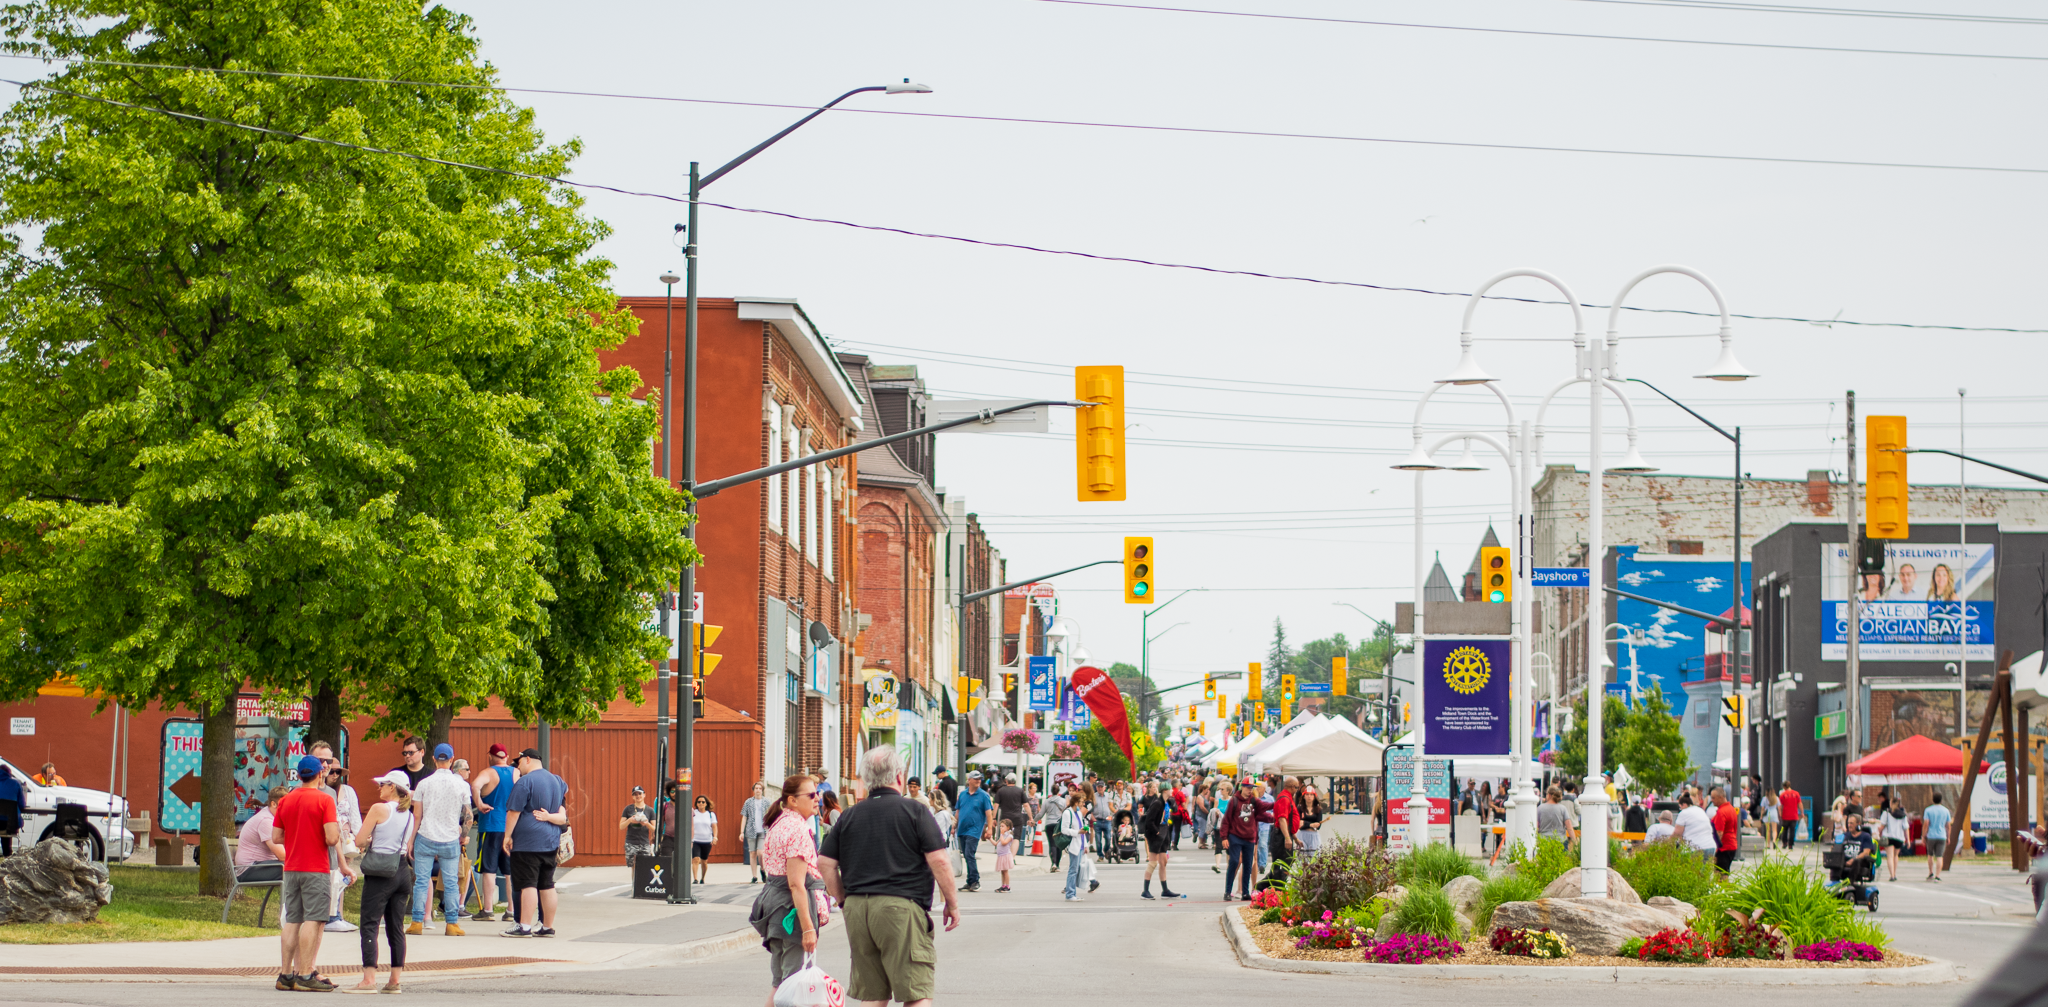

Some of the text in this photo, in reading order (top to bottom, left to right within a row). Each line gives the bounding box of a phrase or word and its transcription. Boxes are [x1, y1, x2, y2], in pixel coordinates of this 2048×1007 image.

[1899, 549, 1947, 558] SELLING?
[1532, 571, 1578, 583] Bayshore
[1836, 620, 1980, 634] GORGIANBAY.ca
